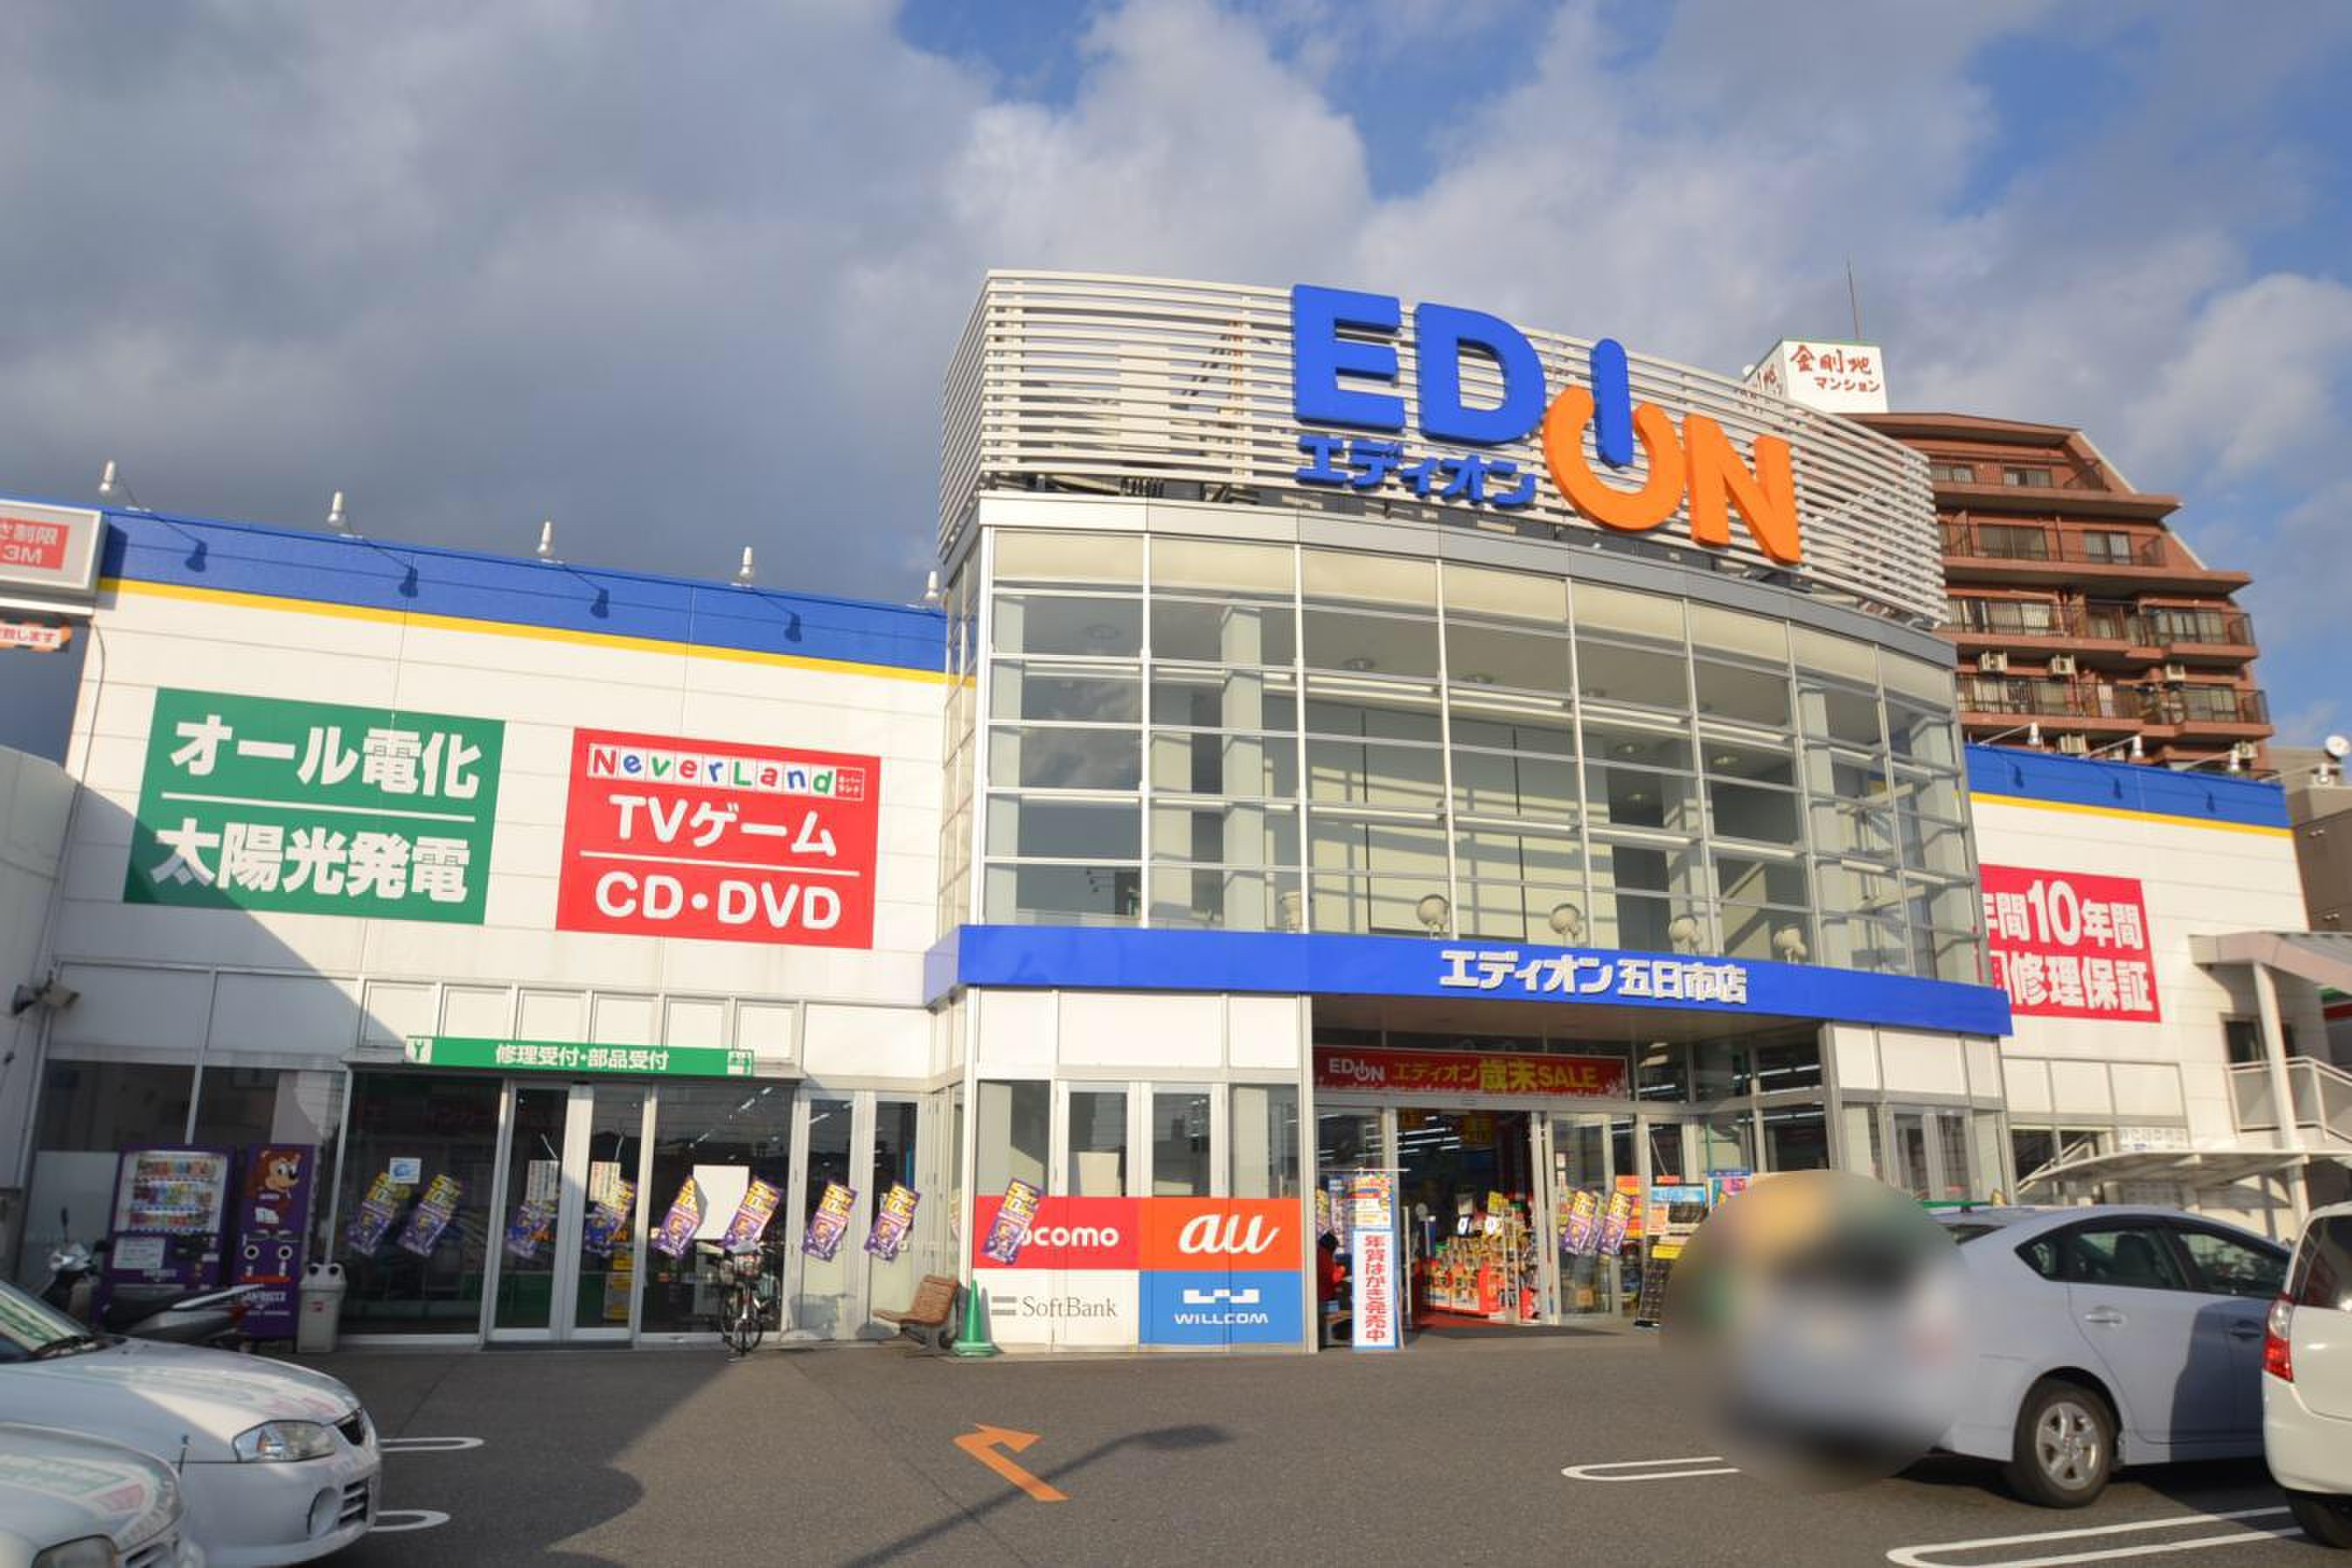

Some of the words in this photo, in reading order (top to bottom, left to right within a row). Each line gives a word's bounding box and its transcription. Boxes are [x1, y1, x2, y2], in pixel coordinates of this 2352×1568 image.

[1813, 375, 1880, 391] マンション
[1291, 283, 1803, 565] EDION
[1294, 435, 1537, 508] エディオン
[170, 714, 482, 801] オール電化
[591, 747, 834, 794] NeverLand
[608, 794, 837, 857] TVゲーム
[152, 817, 471, 903] 太陽光発電
[1328, 1057, 1385, 1083] EDION
[1394, 1060, 1478, 1084] エディオン
[1022, 1226, 1119, 1247] como
[1178, 1213, 1280, 1255] au
[1022, 1295, 1119, 1318] SoftBank
[1174, 1312, 1269, 1326] WILLCOM
